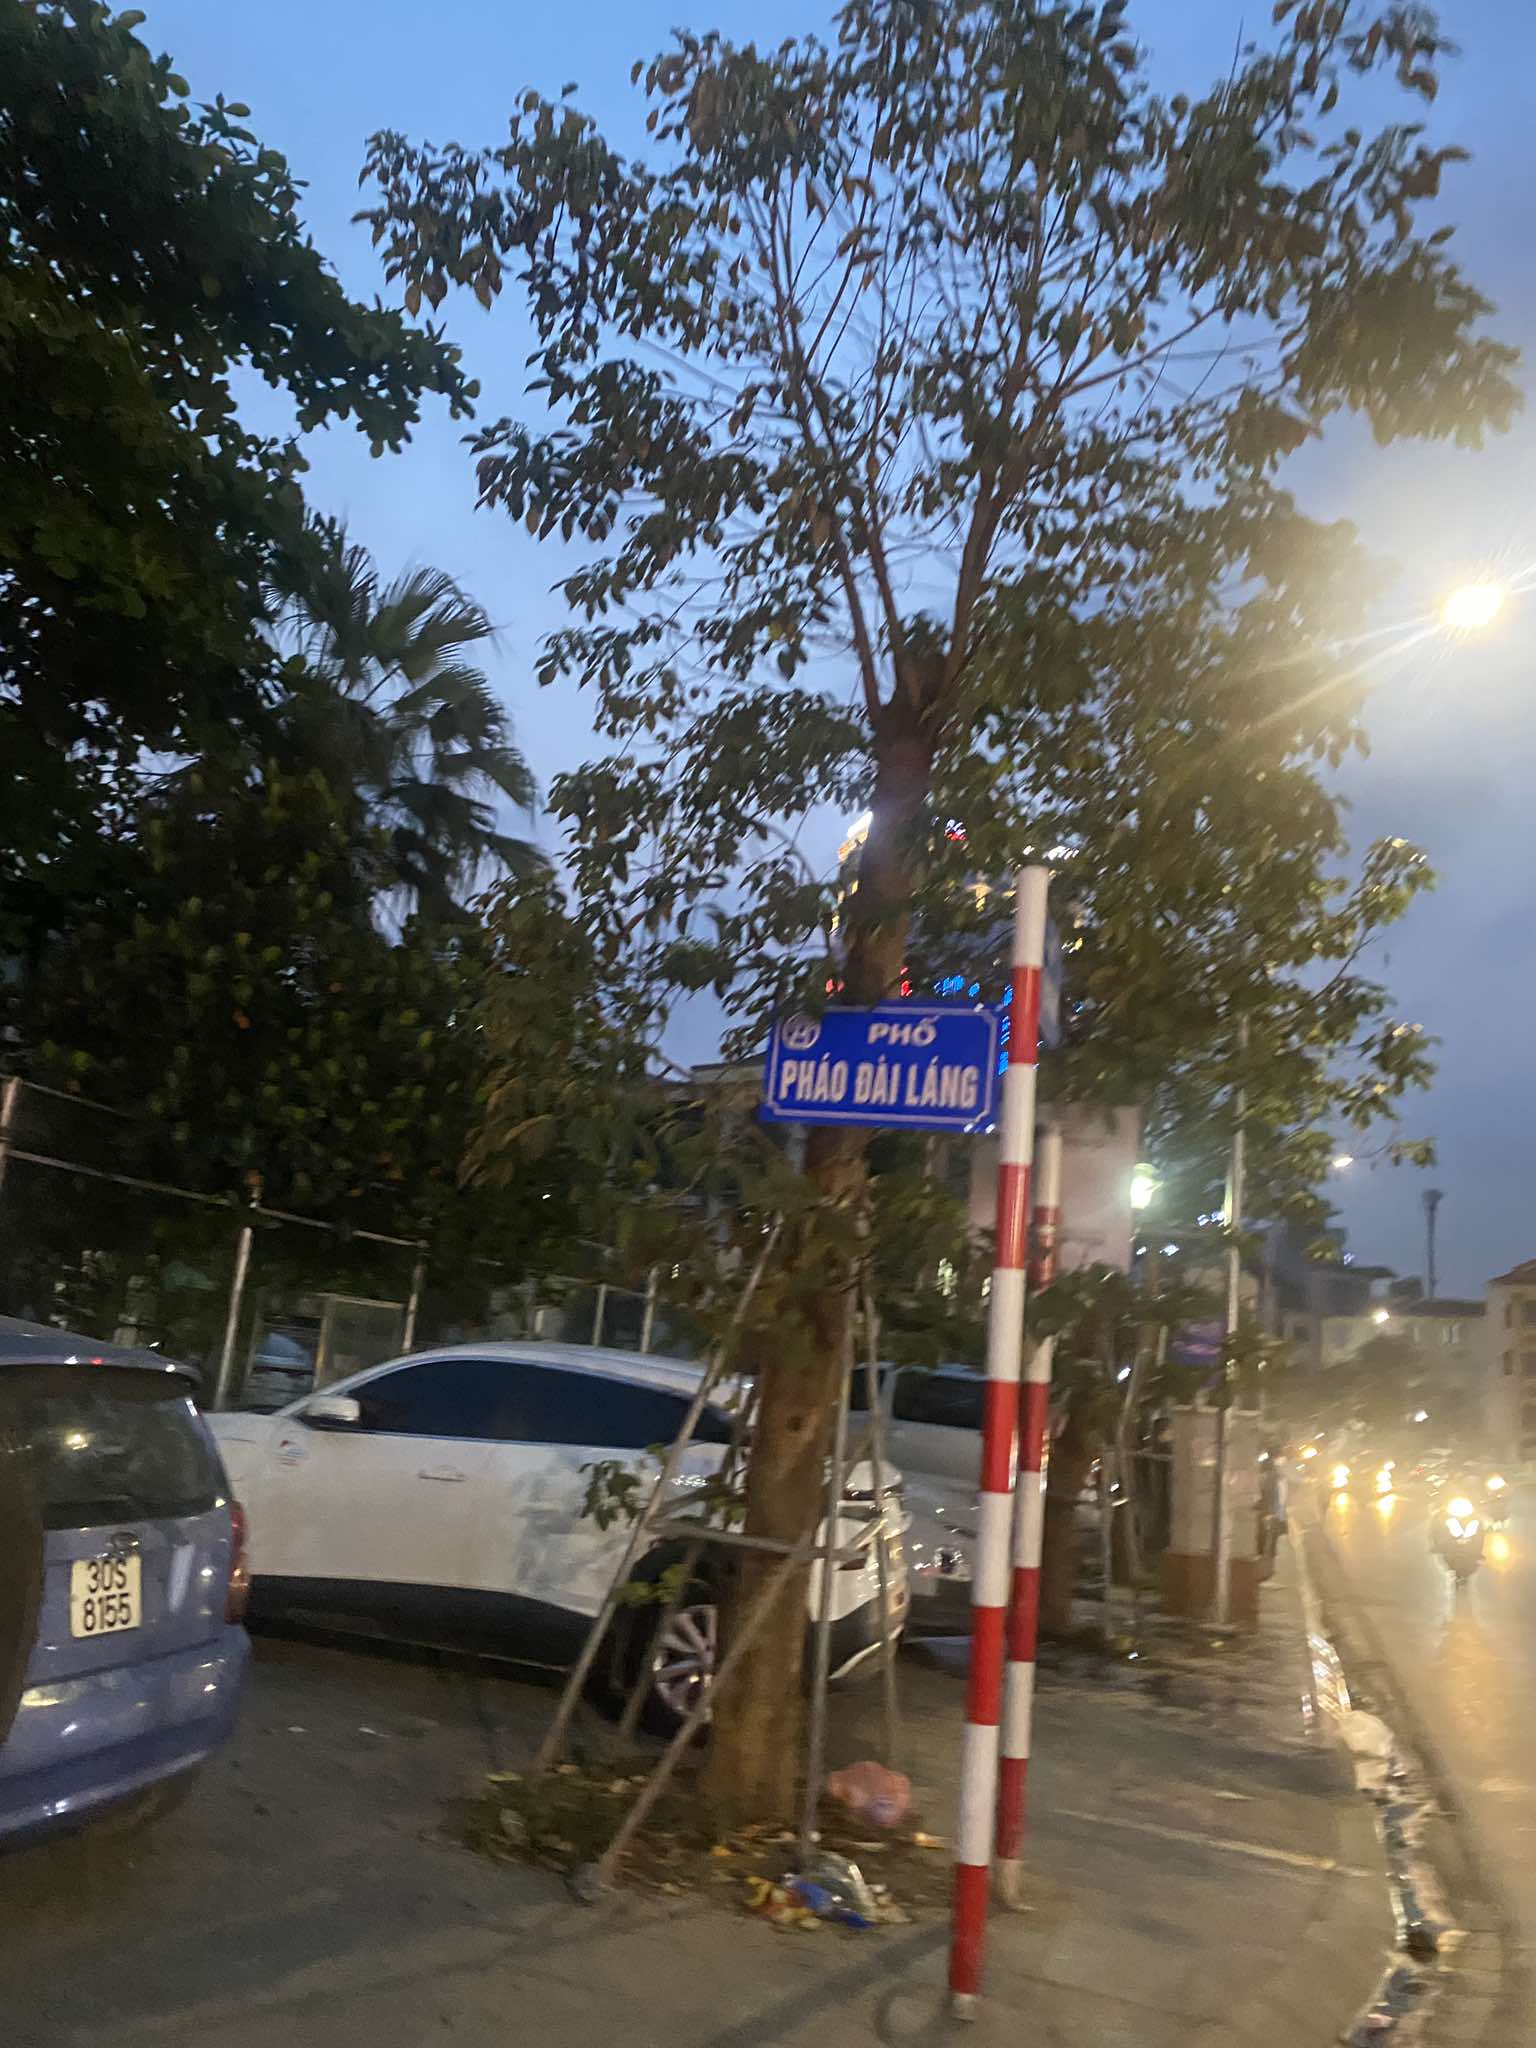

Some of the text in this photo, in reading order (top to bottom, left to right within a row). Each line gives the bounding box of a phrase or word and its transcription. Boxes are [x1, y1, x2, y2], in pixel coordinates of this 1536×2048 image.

[867, 1015, 940, 1047] PHỐ
[779, 1052, 849, 1104] PHÁO
[904, 1055, 979, 1109] LÁNG
[87, 1559, 127, 1593] 30S
[83, 1593, 131, 1631] 8155
